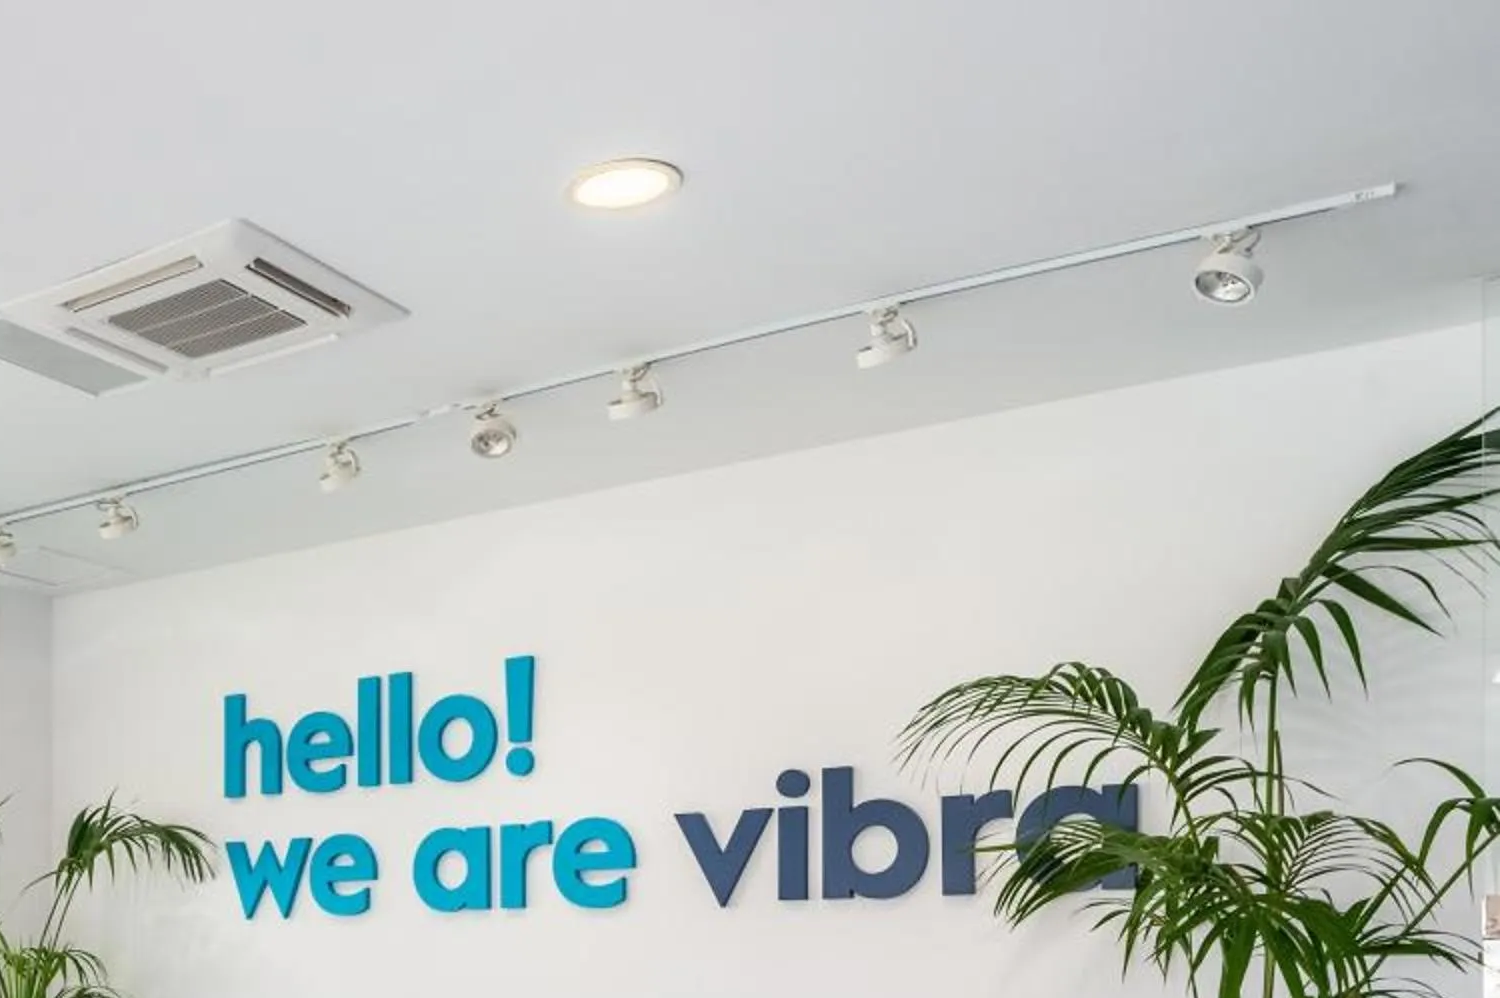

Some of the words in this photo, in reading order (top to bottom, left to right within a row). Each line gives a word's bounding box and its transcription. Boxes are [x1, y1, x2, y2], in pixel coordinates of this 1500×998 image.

[222, 654, 537, 800] hello!
[224, 831, 380, 920] we
[411, 815, 638, 914] are
